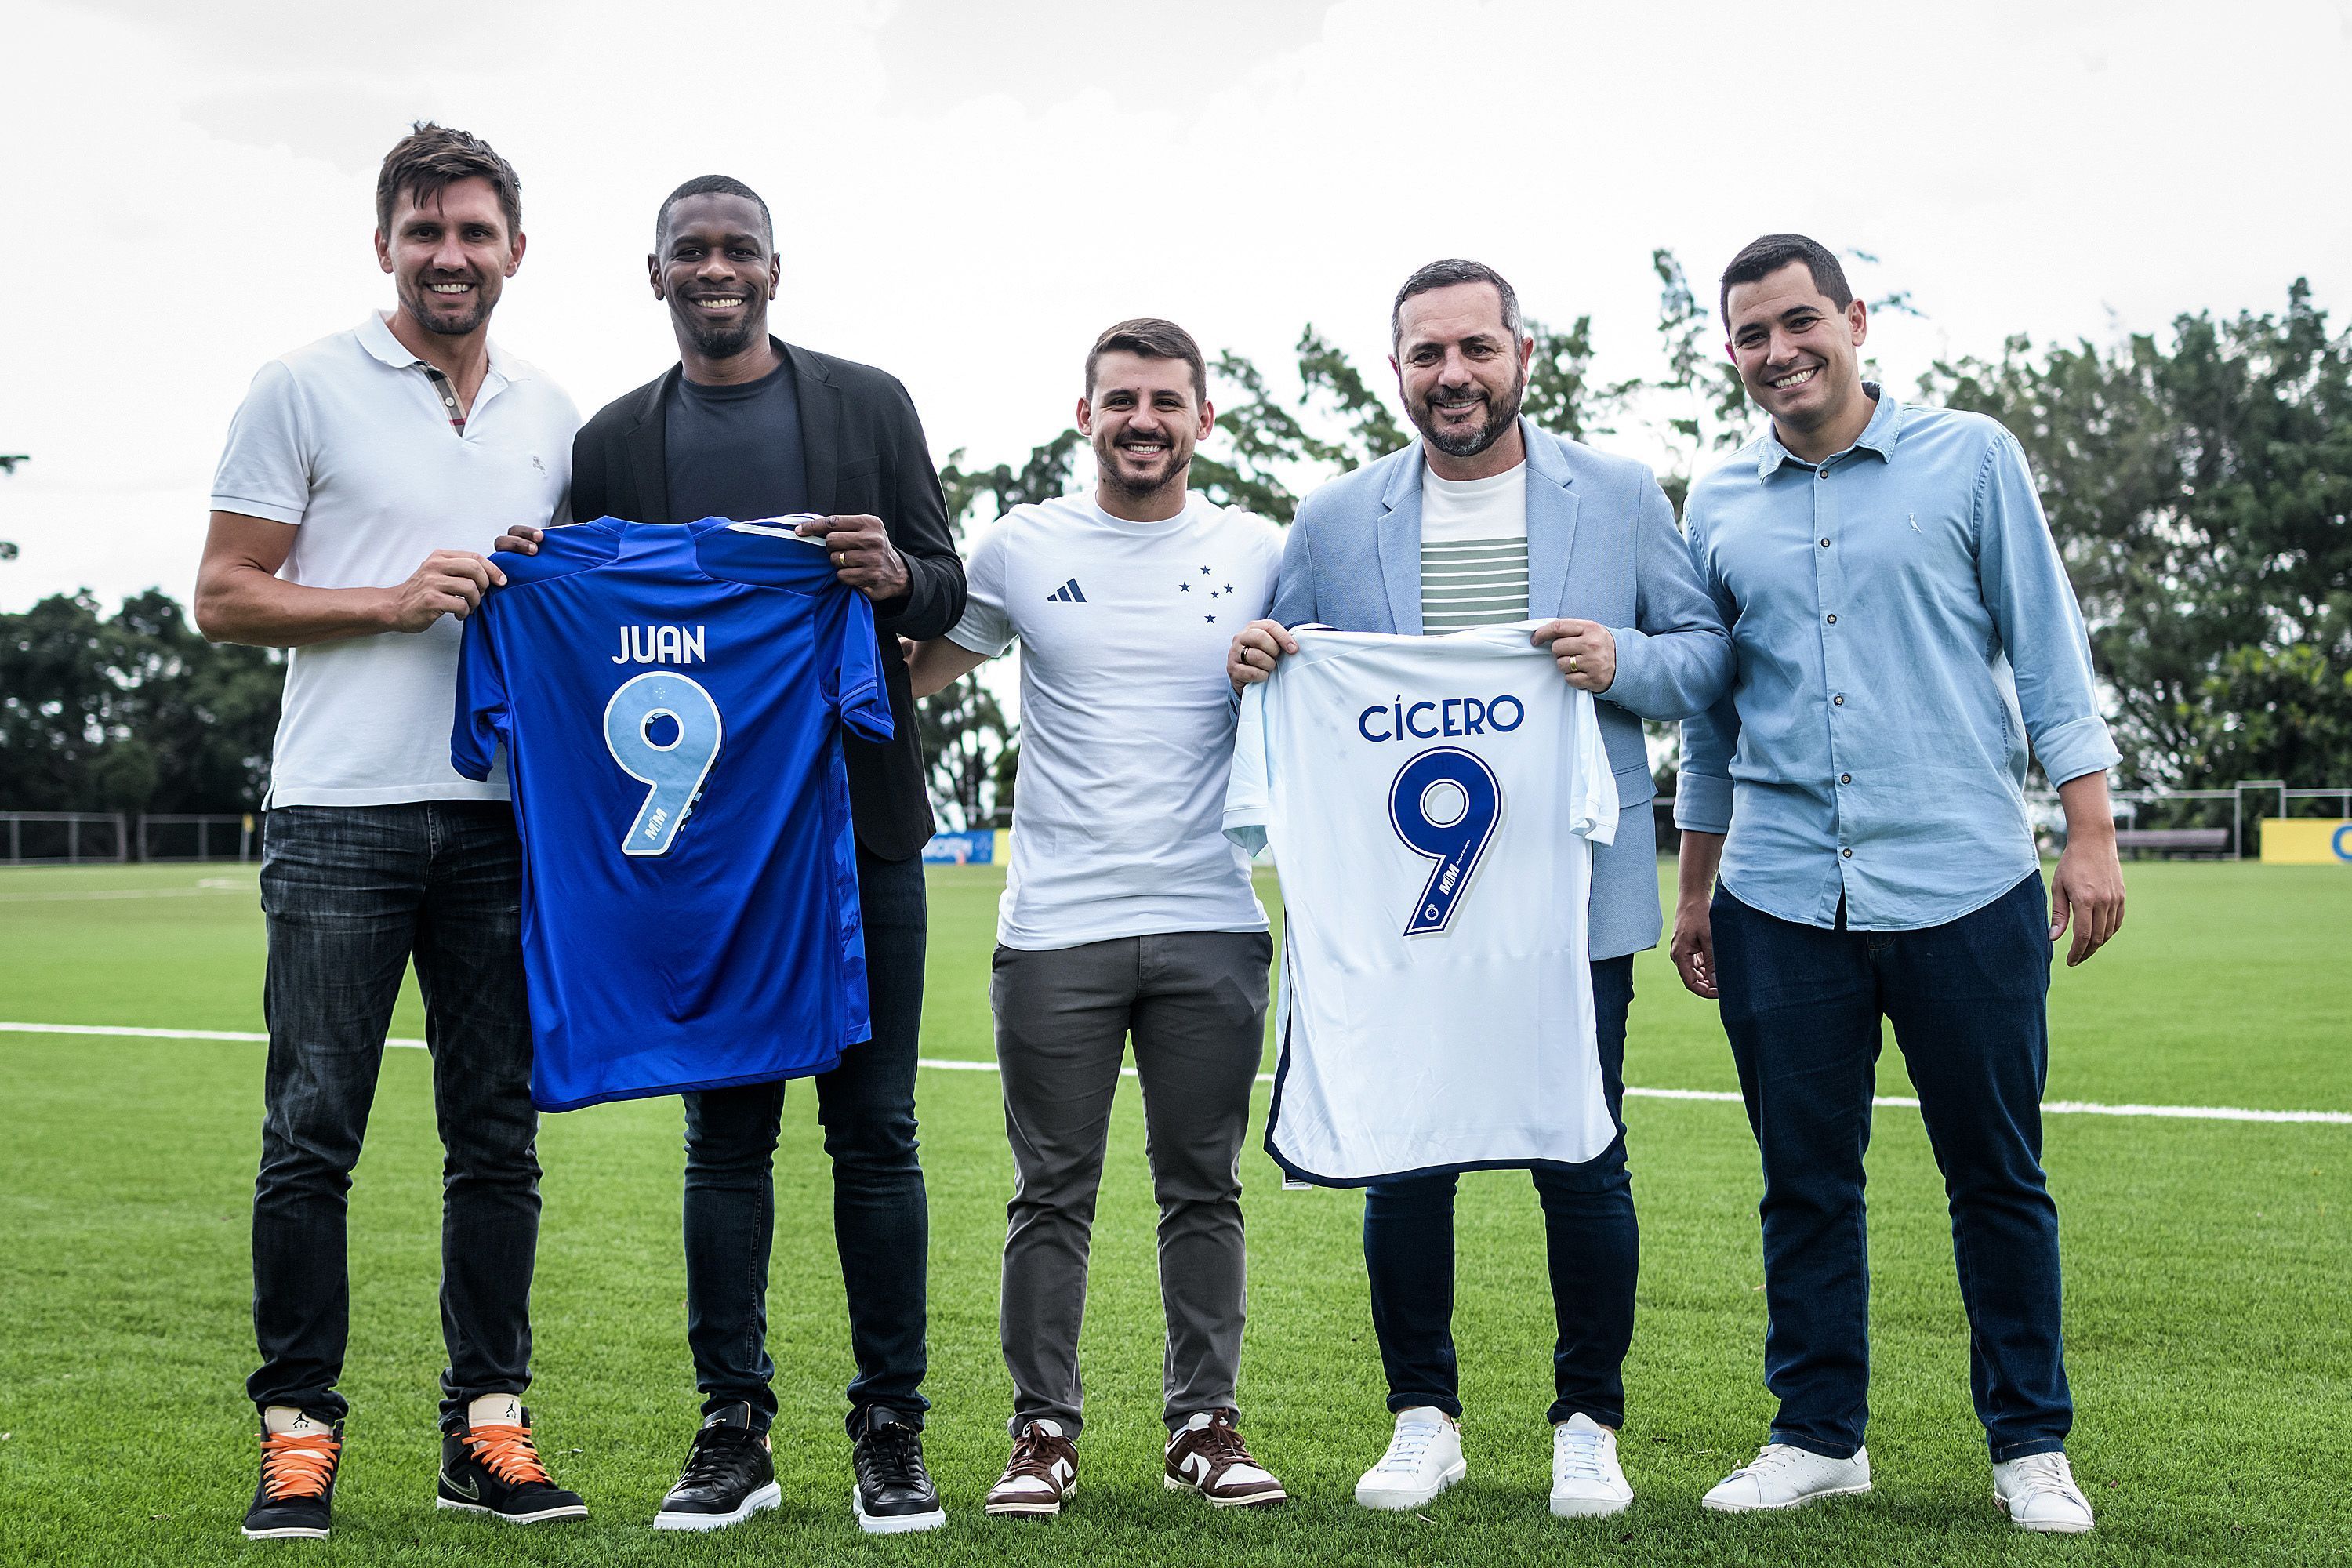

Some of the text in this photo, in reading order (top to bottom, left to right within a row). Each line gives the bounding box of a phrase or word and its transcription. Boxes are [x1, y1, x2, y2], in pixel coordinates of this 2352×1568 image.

[612, 625, 706, 664] JUAN
[603, 670, 723, 855] 9
[1358, 694, 1525, 742] CÍCERO
[1388, 746, 1502, 938] 9
